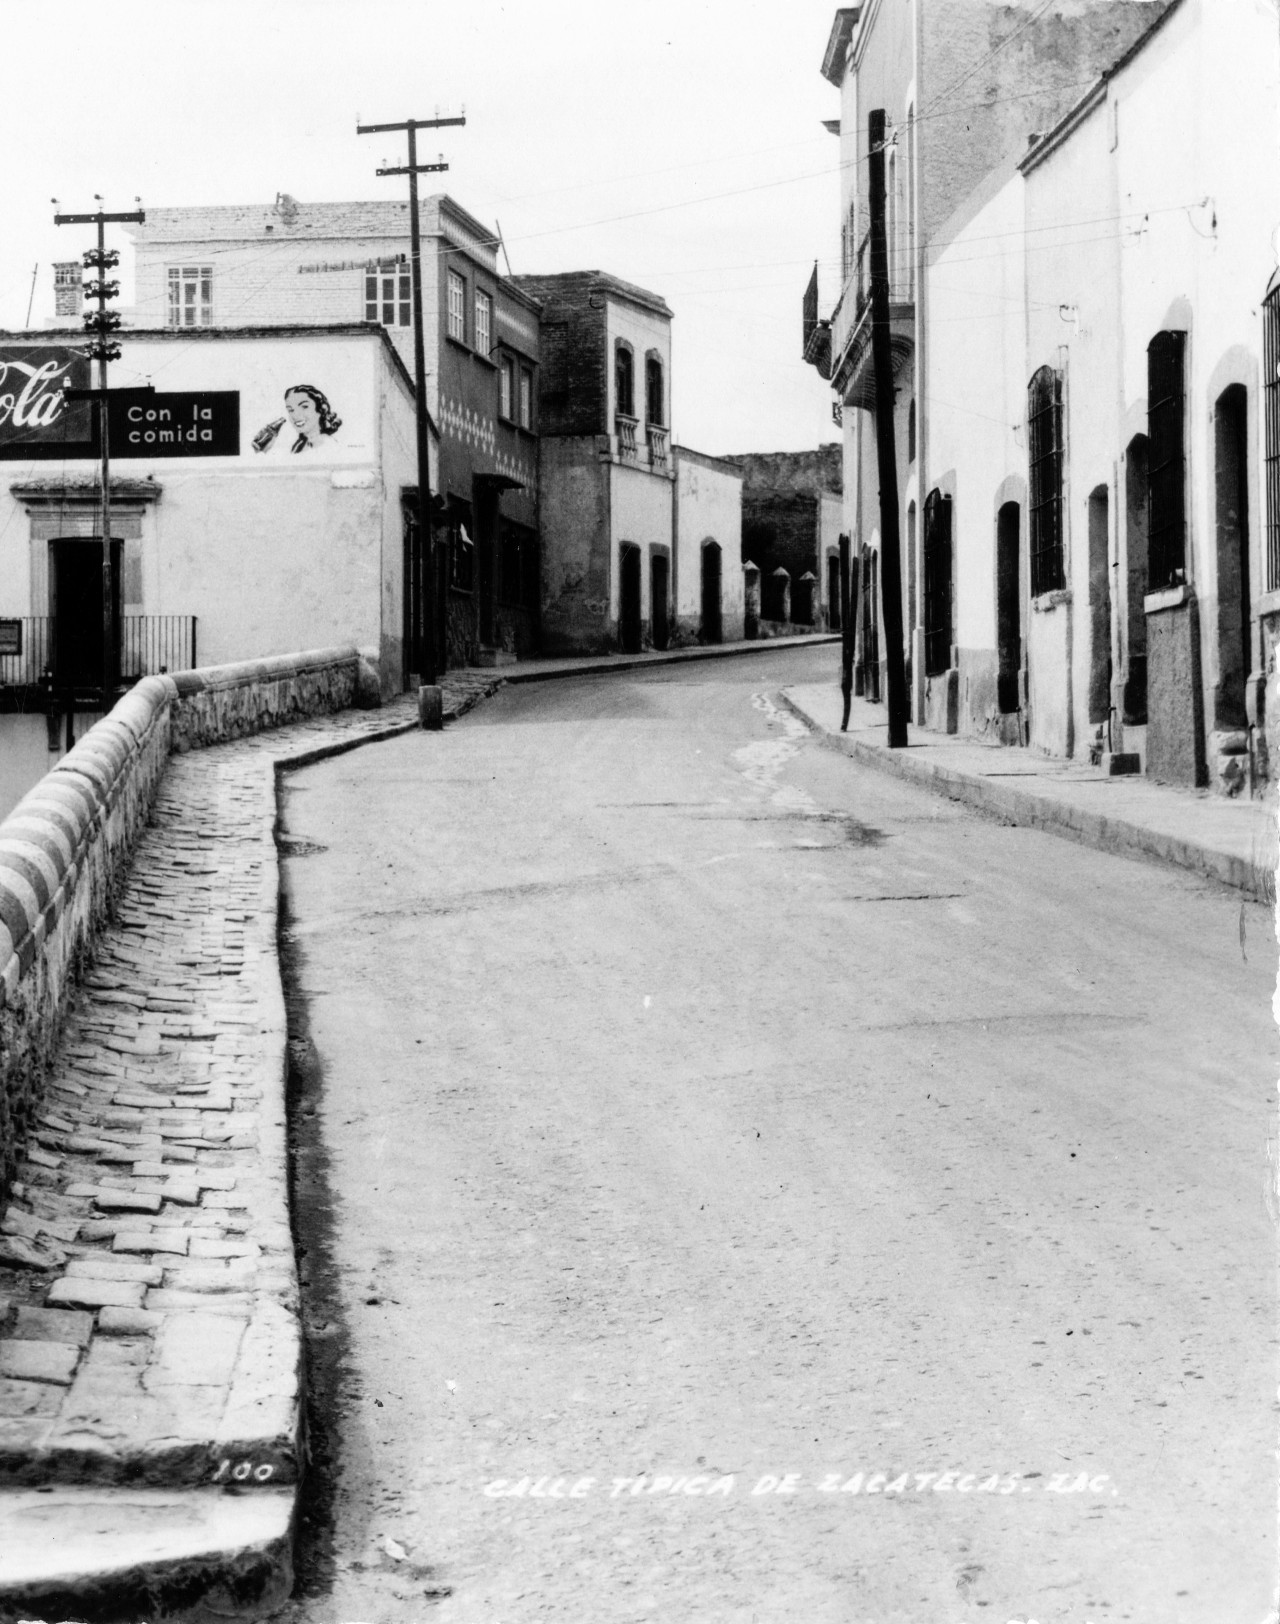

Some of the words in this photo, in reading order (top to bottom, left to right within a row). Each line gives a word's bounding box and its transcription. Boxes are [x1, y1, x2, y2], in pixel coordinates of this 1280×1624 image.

[127, 406, 171, 422] Con
[193, 404, 212, 421] la
[128, 424, 212, 443] comida
